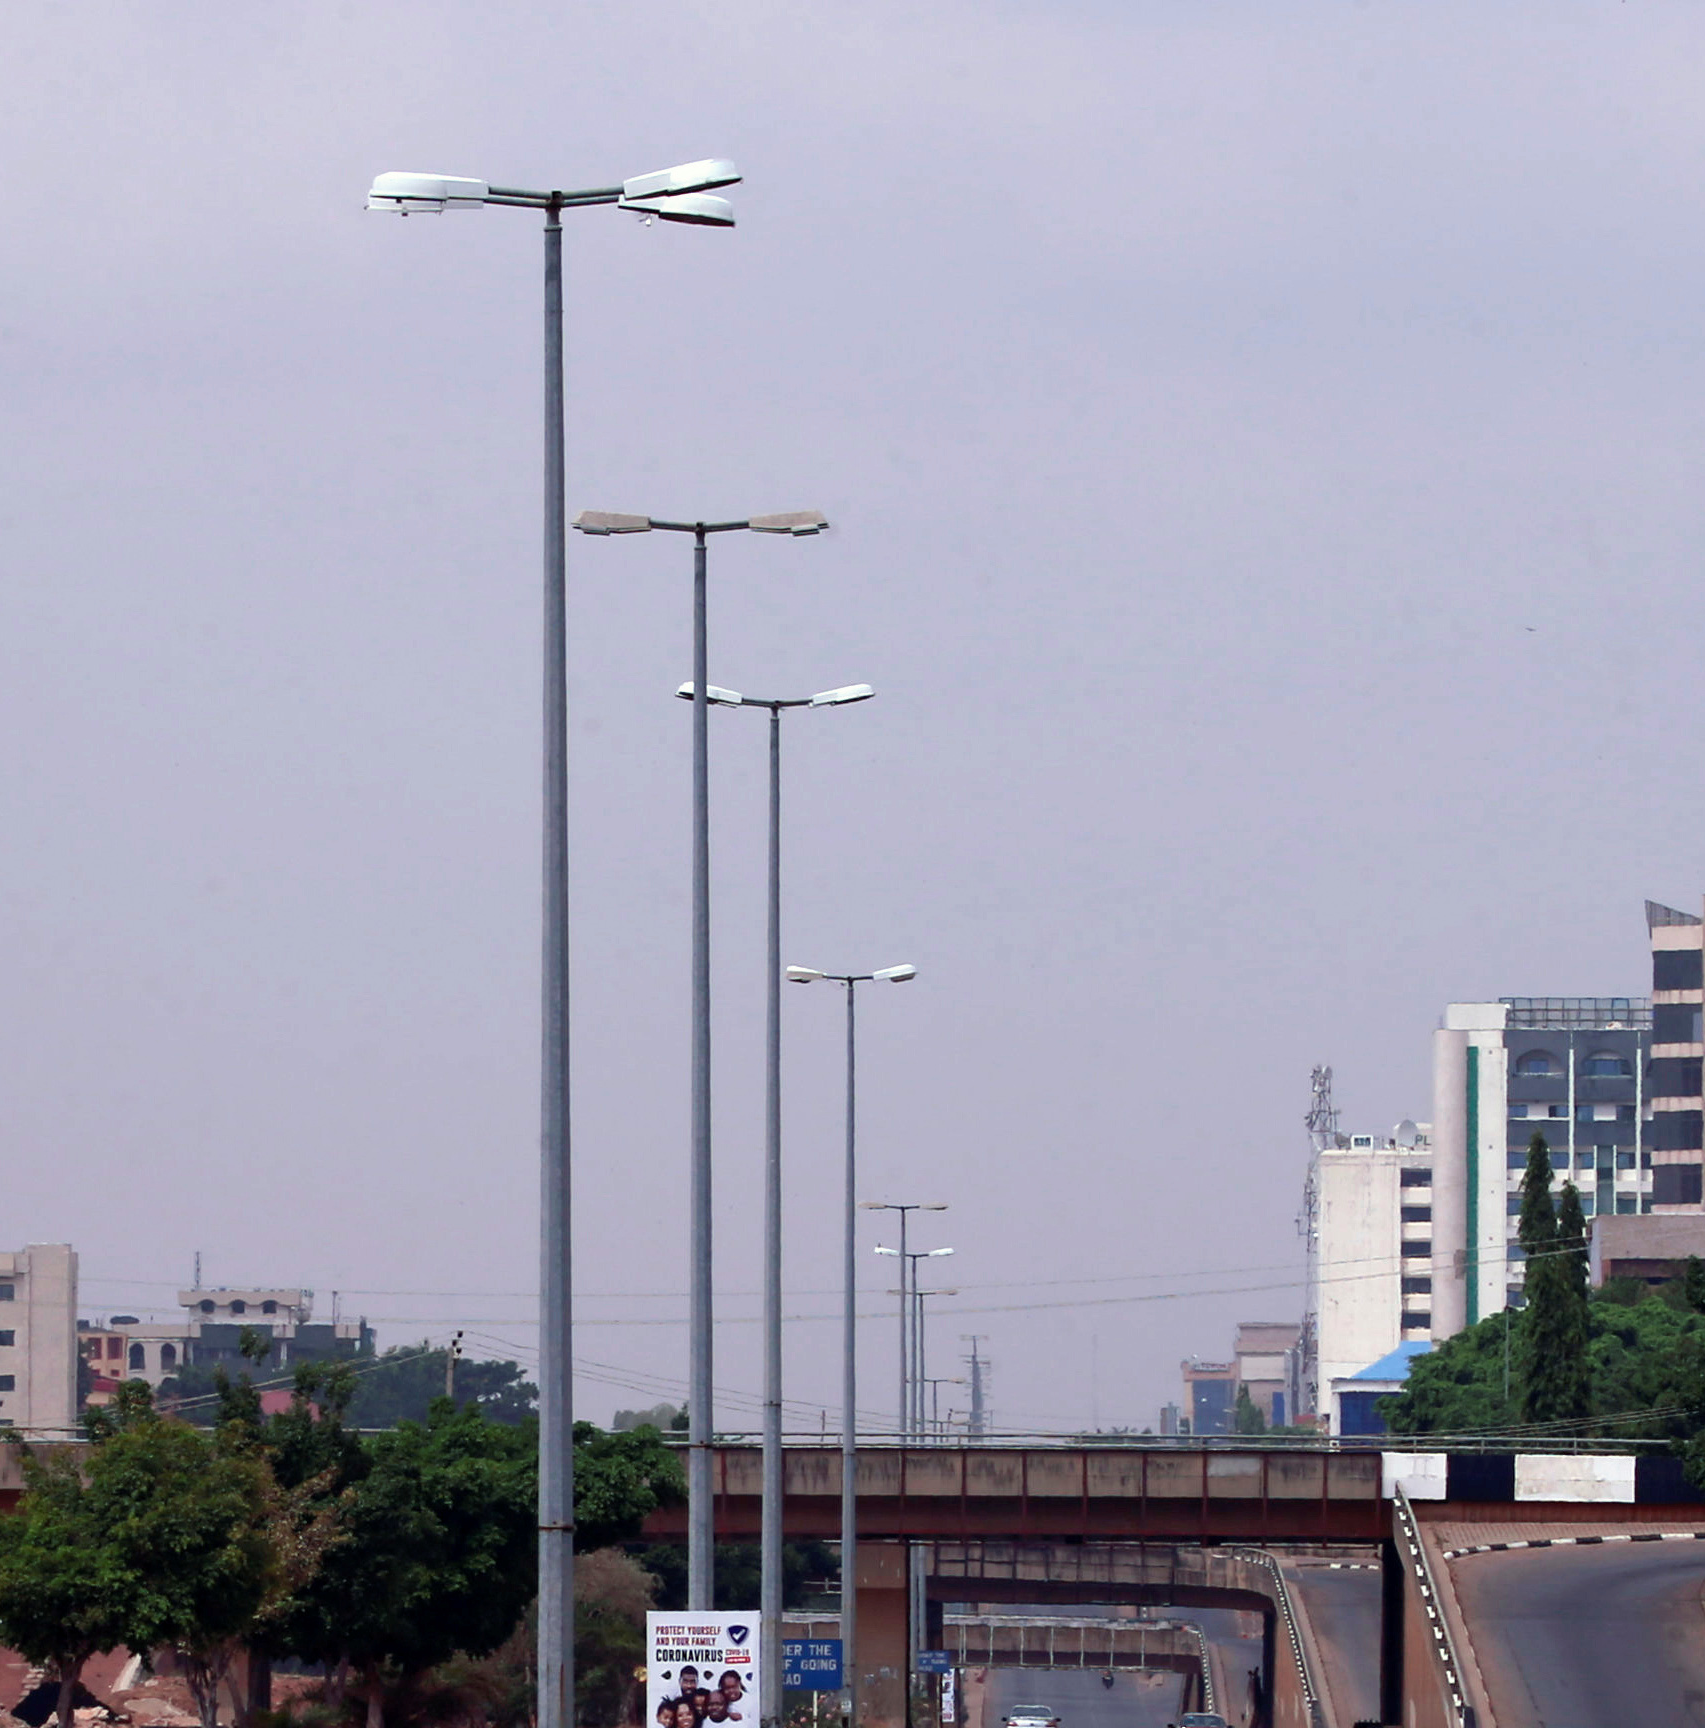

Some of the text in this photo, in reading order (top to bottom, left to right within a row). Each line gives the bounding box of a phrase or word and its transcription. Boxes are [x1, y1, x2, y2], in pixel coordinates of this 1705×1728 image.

[656, 1625, 722, 1635] PROTECT YOURSELF
[656, 1637, 717, 1646] AND YOUR FAMILY
[655, 1648, 724, 1662] CORONAVIRUS
[808, 1644, 833, 1656] THE
[800, 1659, 837, 1671] GOING
